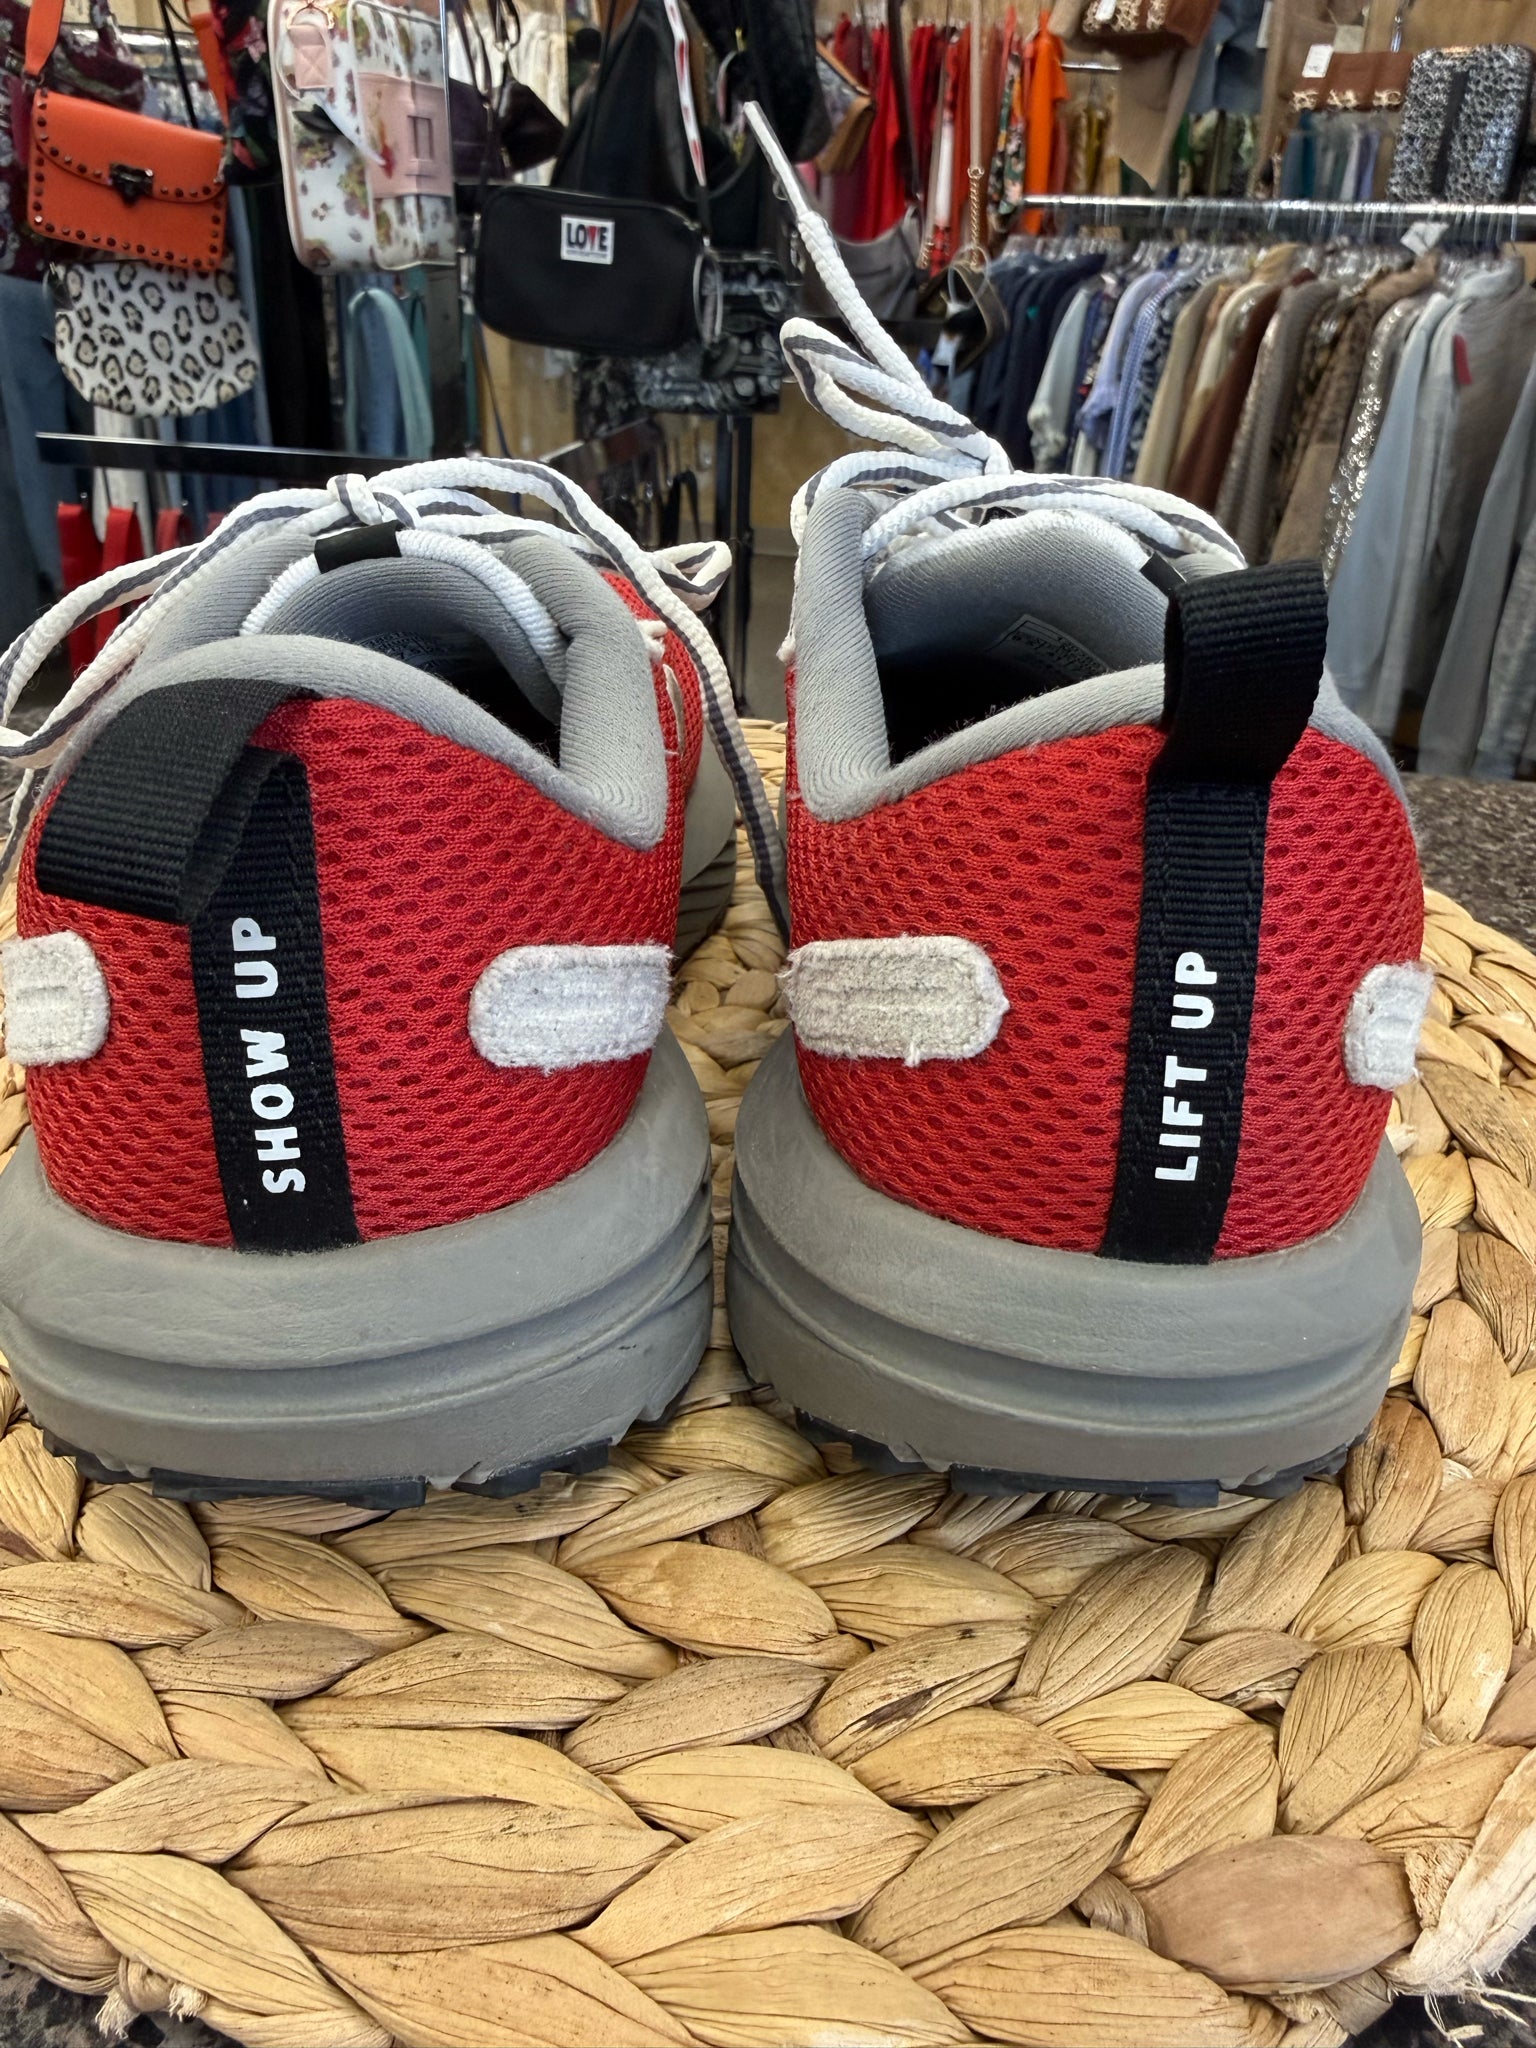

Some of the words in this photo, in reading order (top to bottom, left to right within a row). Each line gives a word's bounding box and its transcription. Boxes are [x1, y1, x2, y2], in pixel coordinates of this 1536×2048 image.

[566, 222, 608, 252] LOVE
[231, 917, 279, 999] UP
[1170, 951, 1218, 1030] UP
[239, 1028, 306, 1194] SHOW
[1154, 1055, 1208, 1182] LIFT
